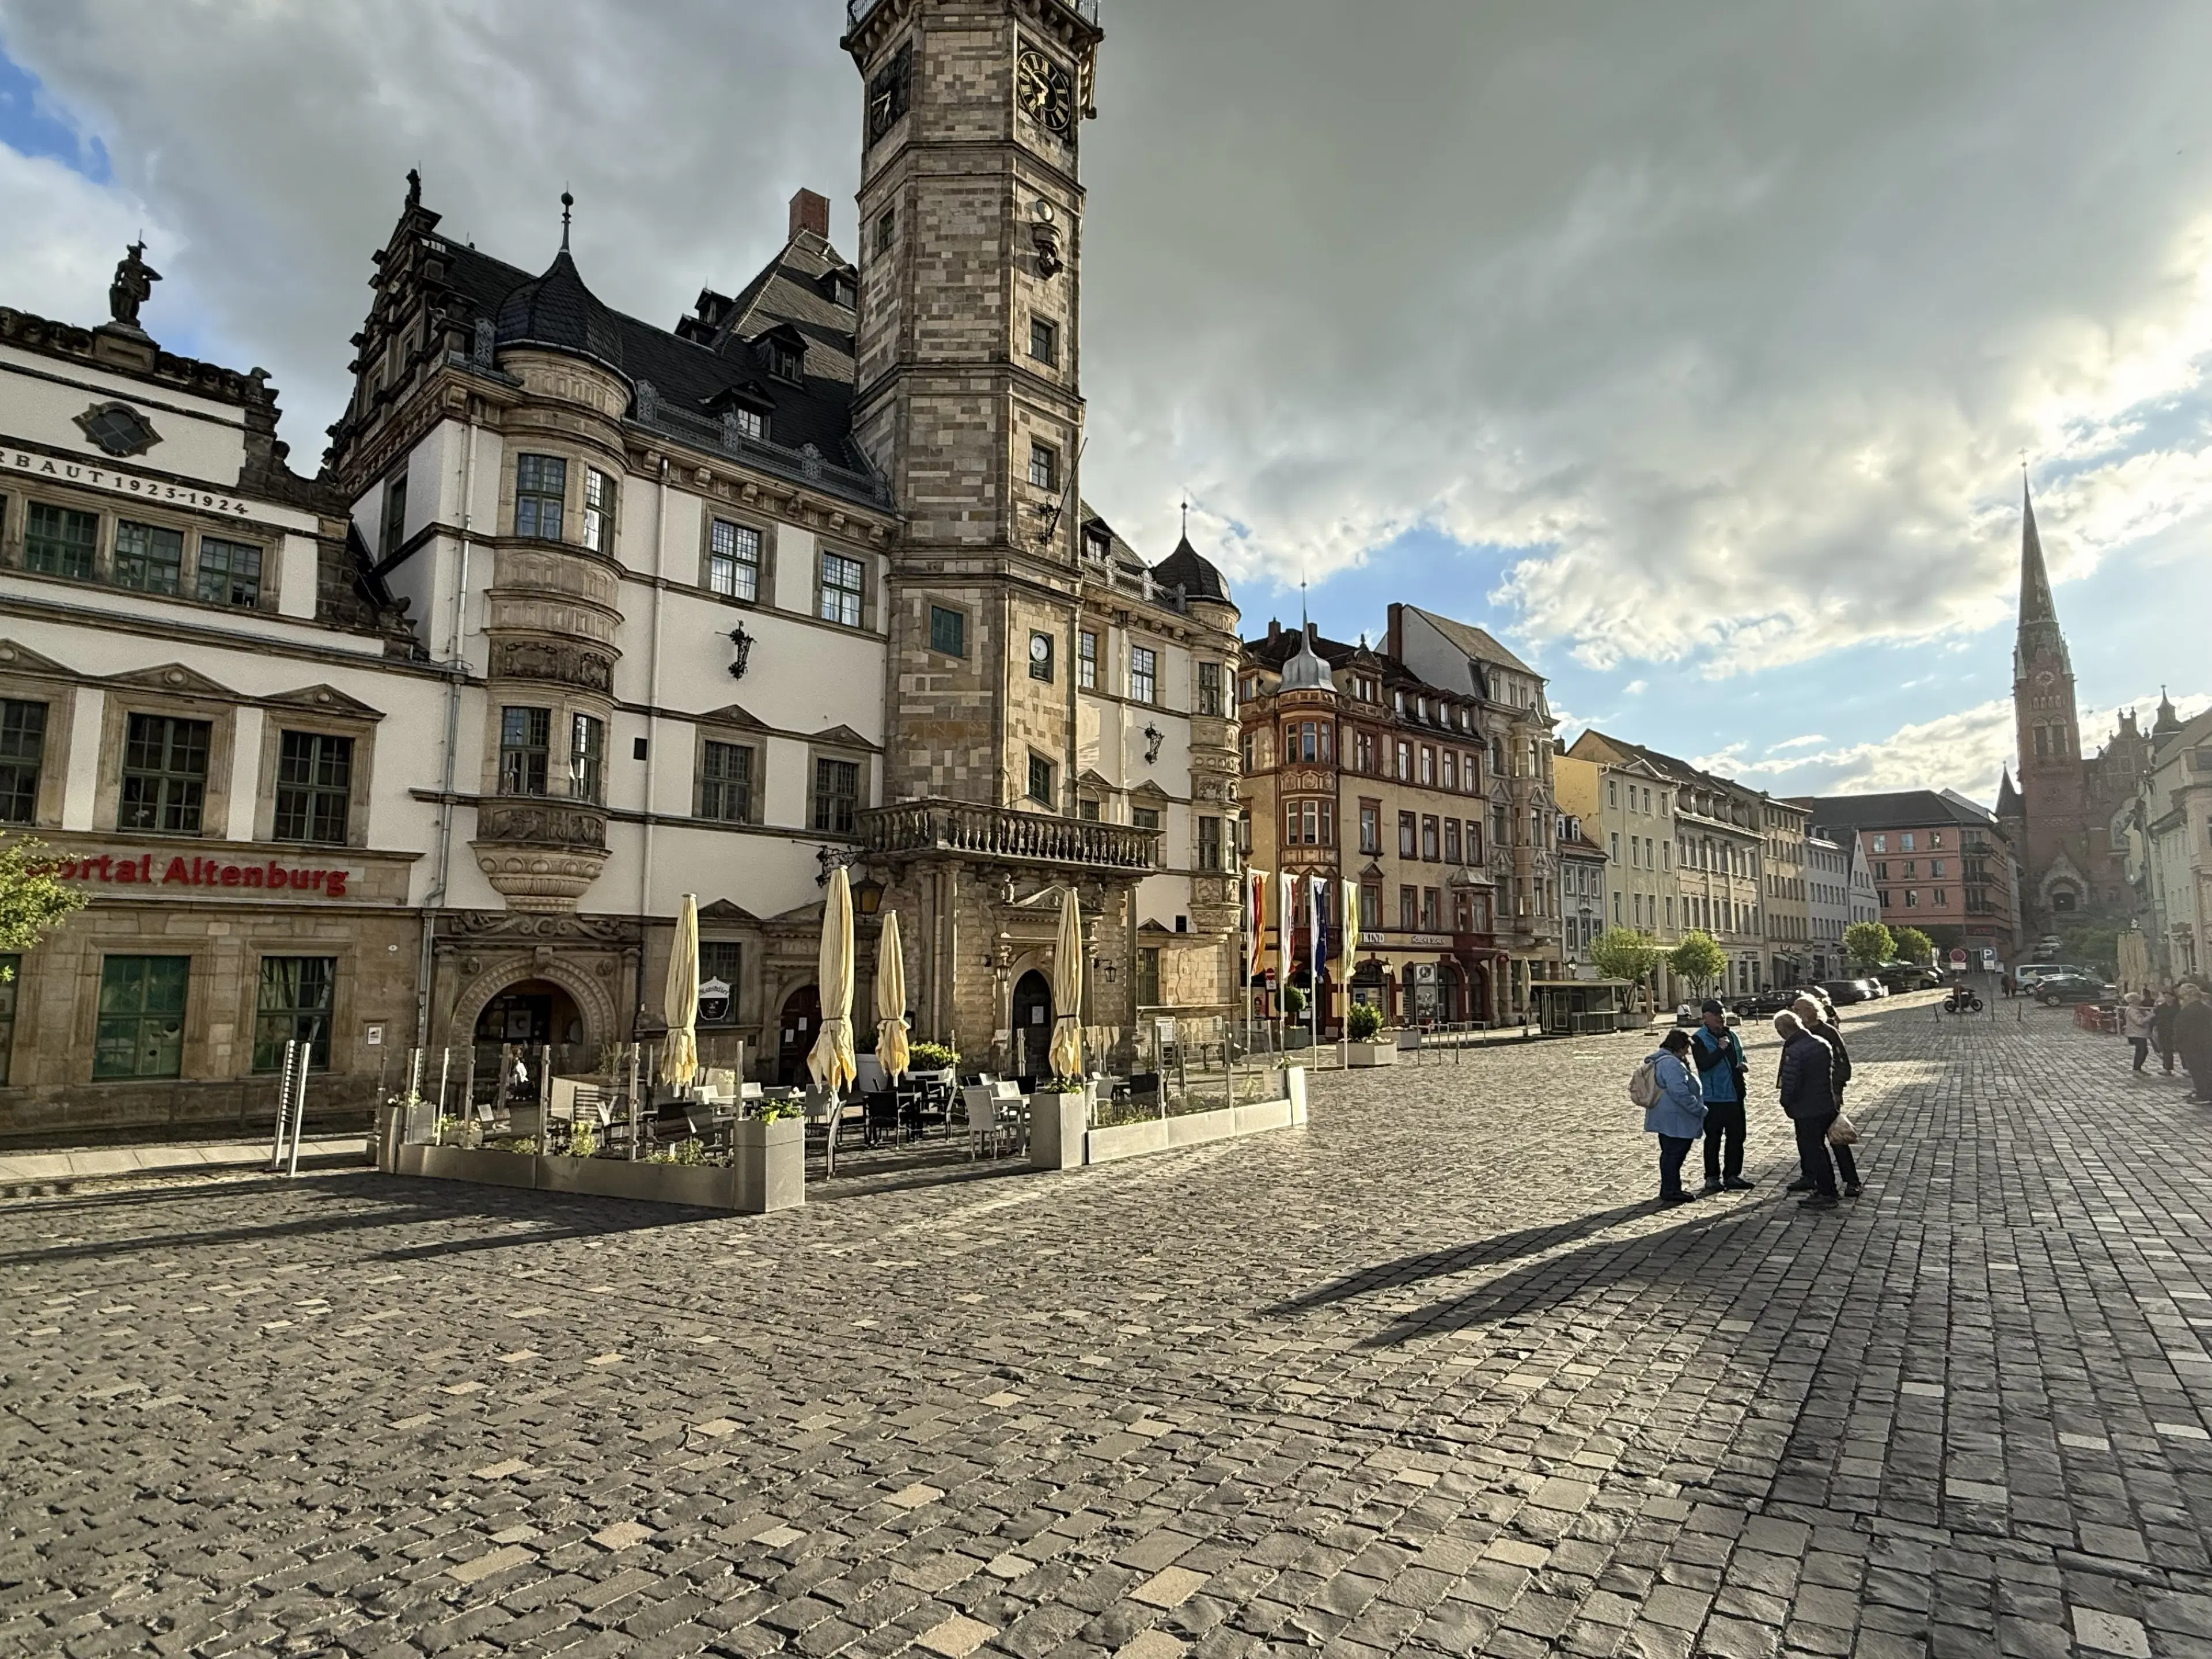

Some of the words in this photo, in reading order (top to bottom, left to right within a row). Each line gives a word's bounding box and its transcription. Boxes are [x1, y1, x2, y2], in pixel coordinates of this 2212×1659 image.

[115, 476, 248, 514] 1923-1924
[162, 856, 350, 897] Altenburg
[1363, 933, 1385, 943] KIND
[1983, 949, 1993, 959] P
